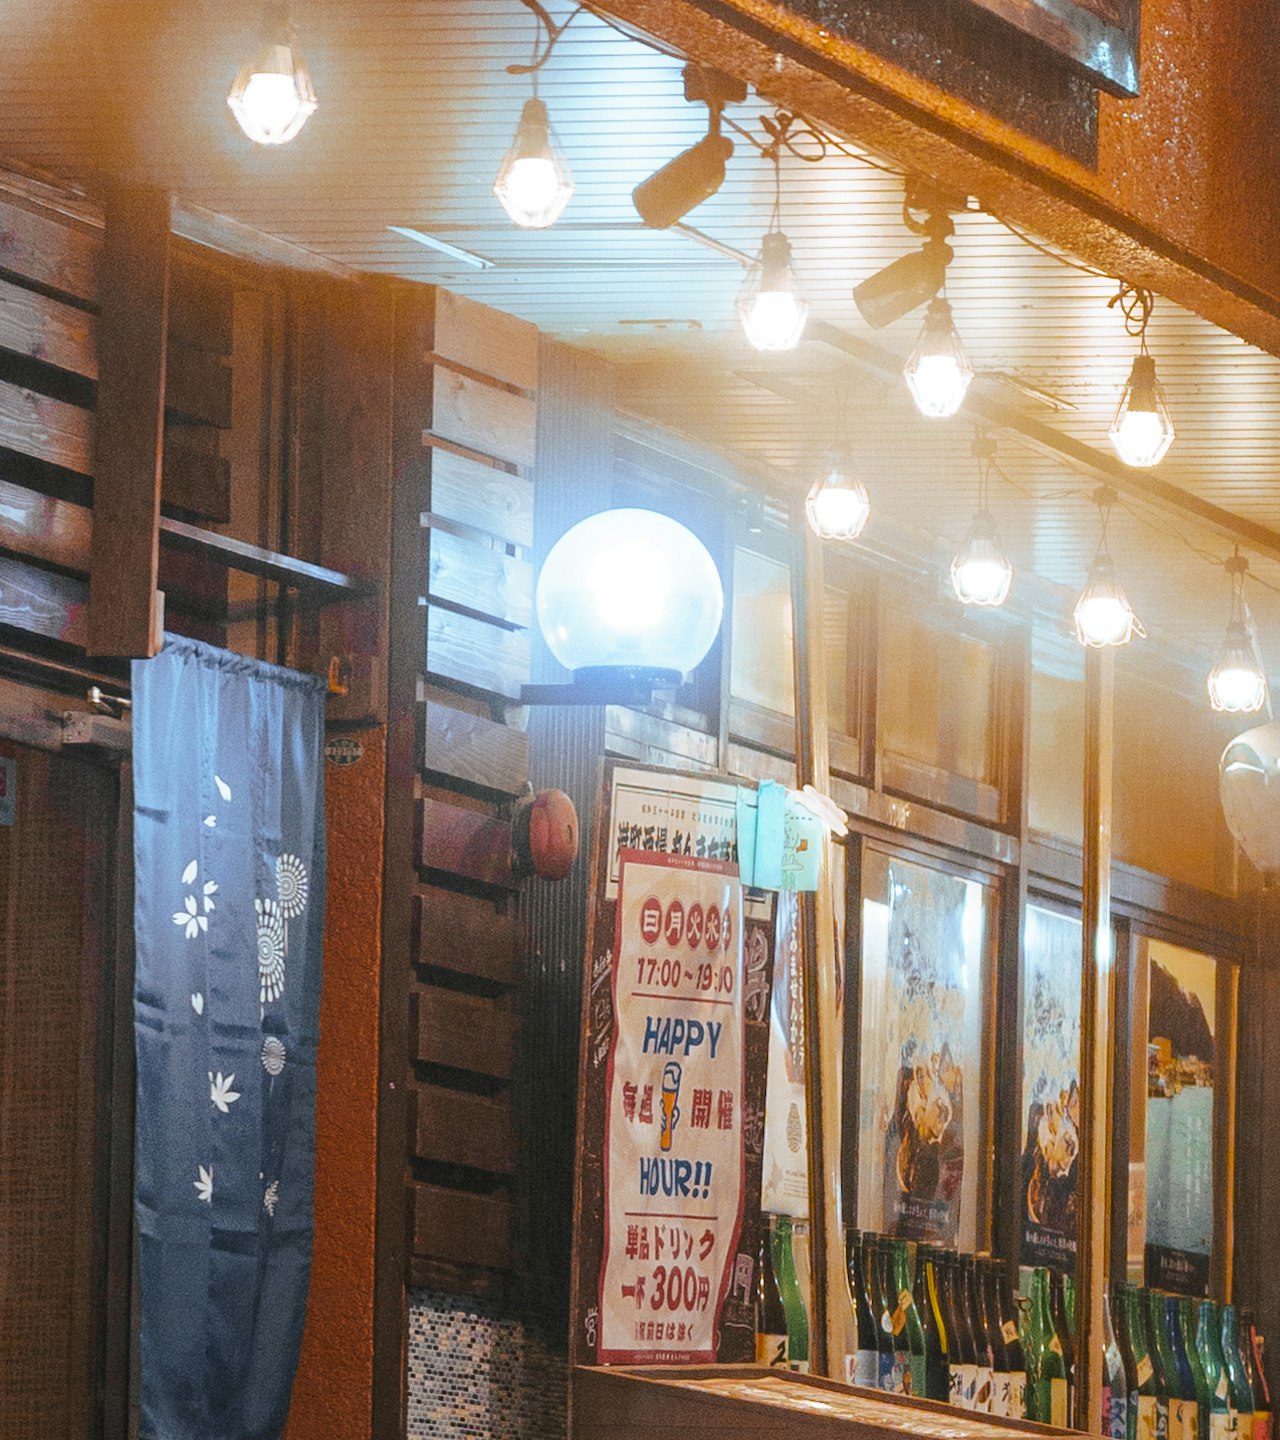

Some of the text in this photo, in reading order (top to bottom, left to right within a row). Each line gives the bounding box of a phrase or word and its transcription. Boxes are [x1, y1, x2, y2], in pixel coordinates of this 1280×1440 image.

[642, 1016, 722, 1058] HAPPY
[623, 1081, 654, 1124] 毎週
[690, 1088, 733, 1130] 開催
[639, 1157, 712, 1199] HOUR!!
[626, 1224, 715, 1261] 単品ドリンク
